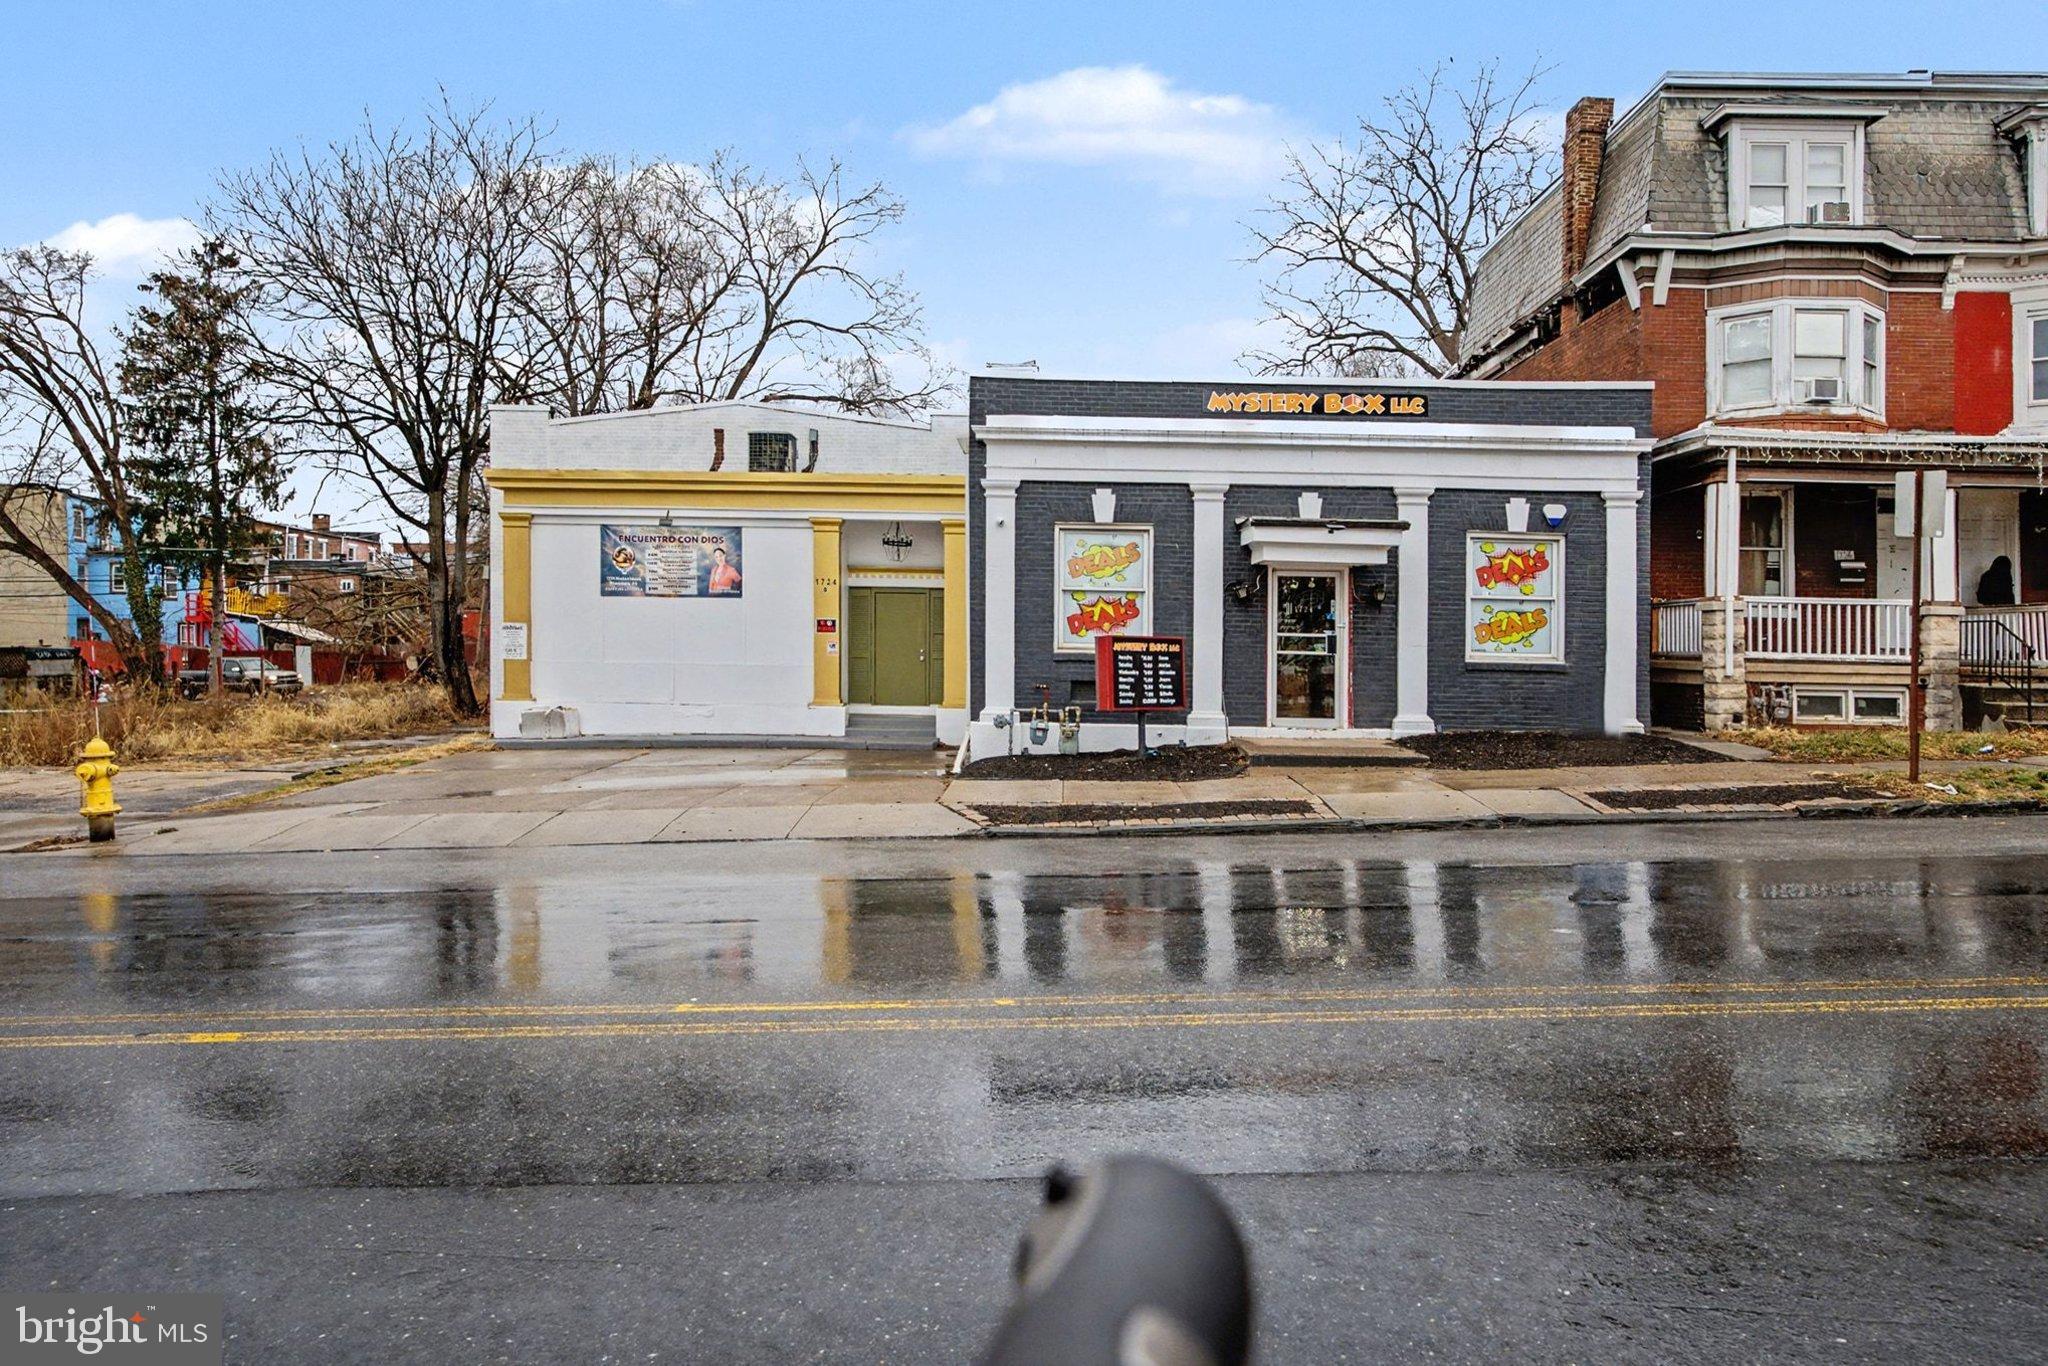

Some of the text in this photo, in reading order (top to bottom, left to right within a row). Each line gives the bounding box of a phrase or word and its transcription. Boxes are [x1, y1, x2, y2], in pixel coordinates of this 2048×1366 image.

[1207, 391, 1425, 414] MYSTERY BOX LLC
[619, 534, 724, 544] ENCUENTRO CON DIOS
[1067, 542, 1141, 579] DEALS
[1475, 551, 1549, 588] DEALS
[1067, 599, 1140, 635] DEALS
[1473, 608, 1549, 644] DEALS
